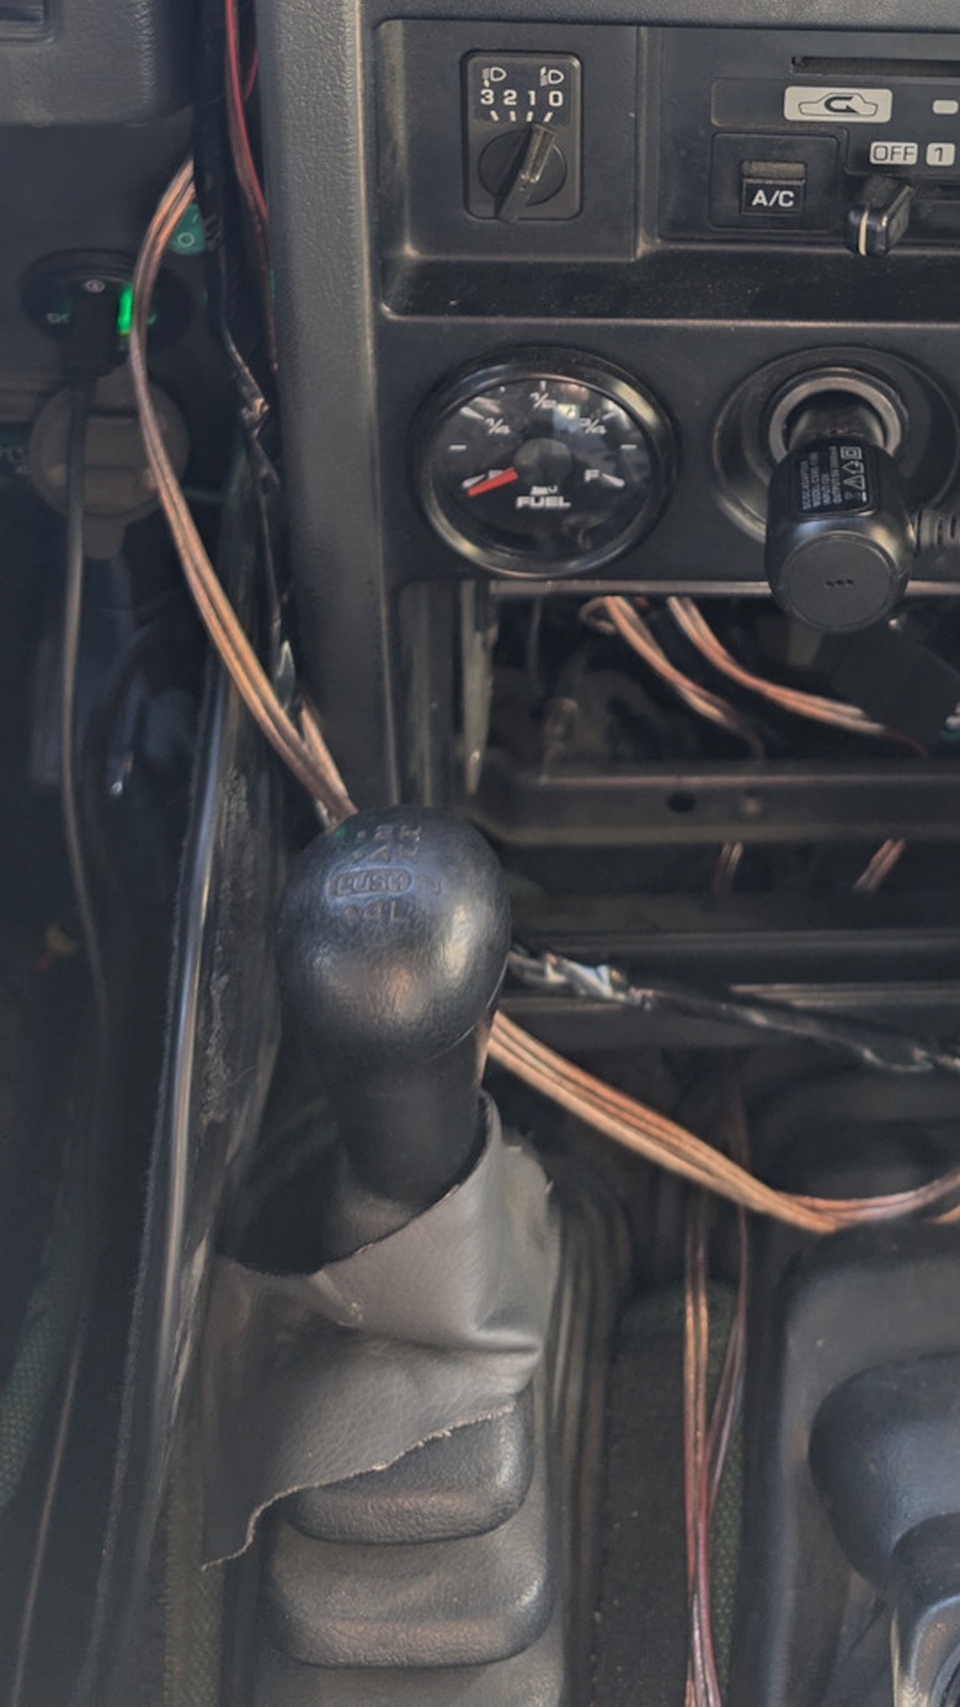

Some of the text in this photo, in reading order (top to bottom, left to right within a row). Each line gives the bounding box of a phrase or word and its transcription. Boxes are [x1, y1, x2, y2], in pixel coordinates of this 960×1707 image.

[480, 89, 563, 108] 3 2 1 0
[873, 145, 915, 162] OFF
[934, 147, 944, 162] 1
[751, 189, 795, 208] A/C
[516, 495, 571, 508] FUEL
